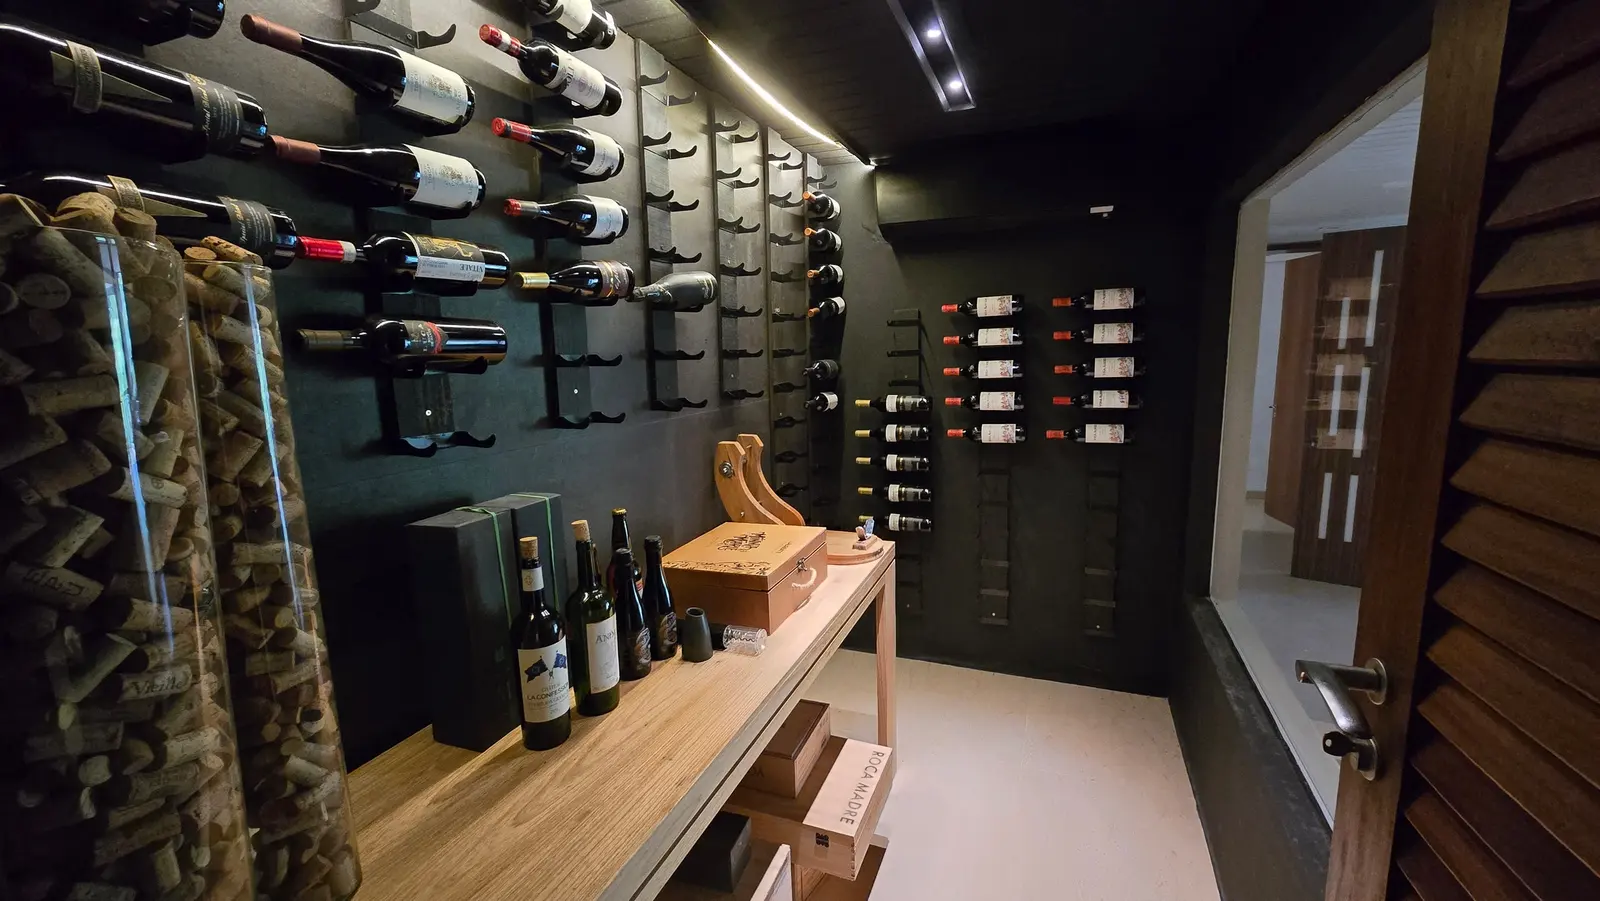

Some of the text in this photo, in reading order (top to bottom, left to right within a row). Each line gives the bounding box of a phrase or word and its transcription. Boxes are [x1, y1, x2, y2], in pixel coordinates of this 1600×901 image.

[459, 263, 484, 273] VITALE
[839, 750, 885, 825] ROCA MADRE
